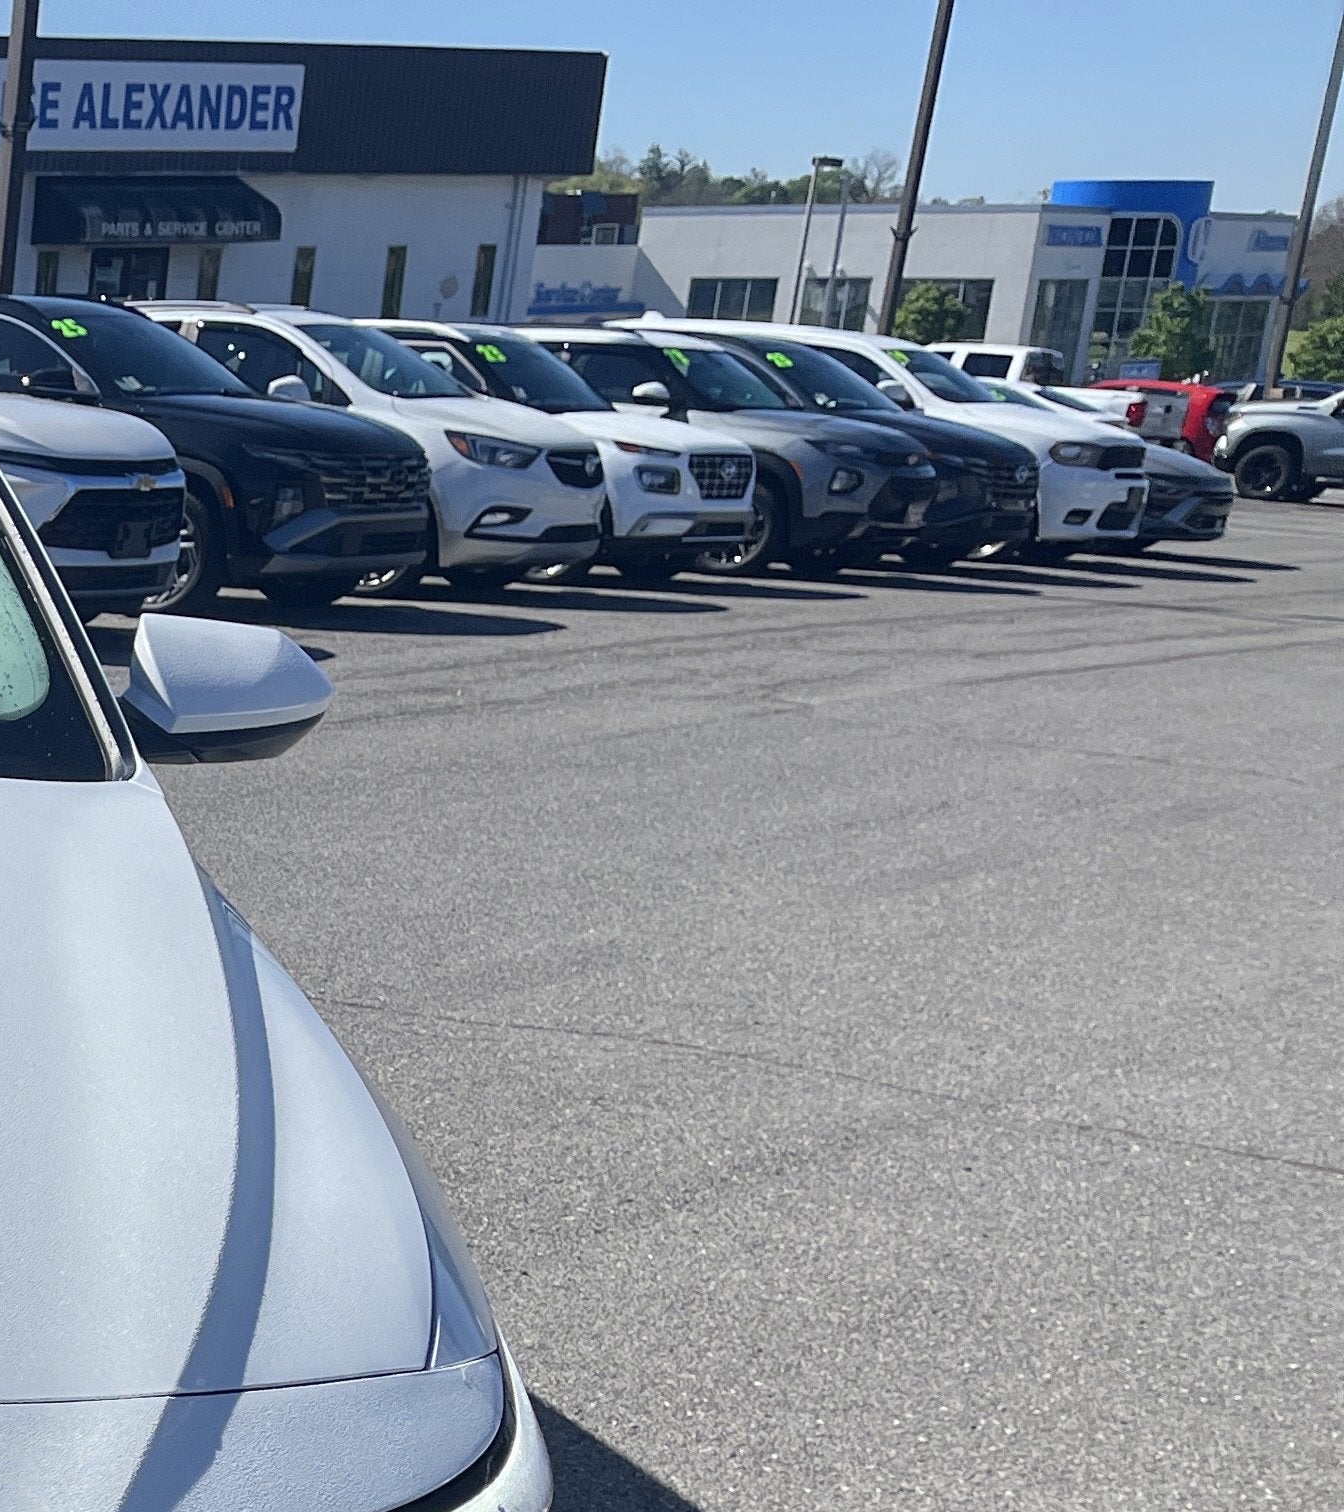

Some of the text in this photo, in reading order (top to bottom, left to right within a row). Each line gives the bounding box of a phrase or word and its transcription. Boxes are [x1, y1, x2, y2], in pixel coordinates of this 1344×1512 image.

[72, 82, 296, 131] ALEXANDER
[101, 221, 140, 237] PARTS
[157, 221, 208, 237] SERVICE
[214, 220, 263, 237] CENTER
